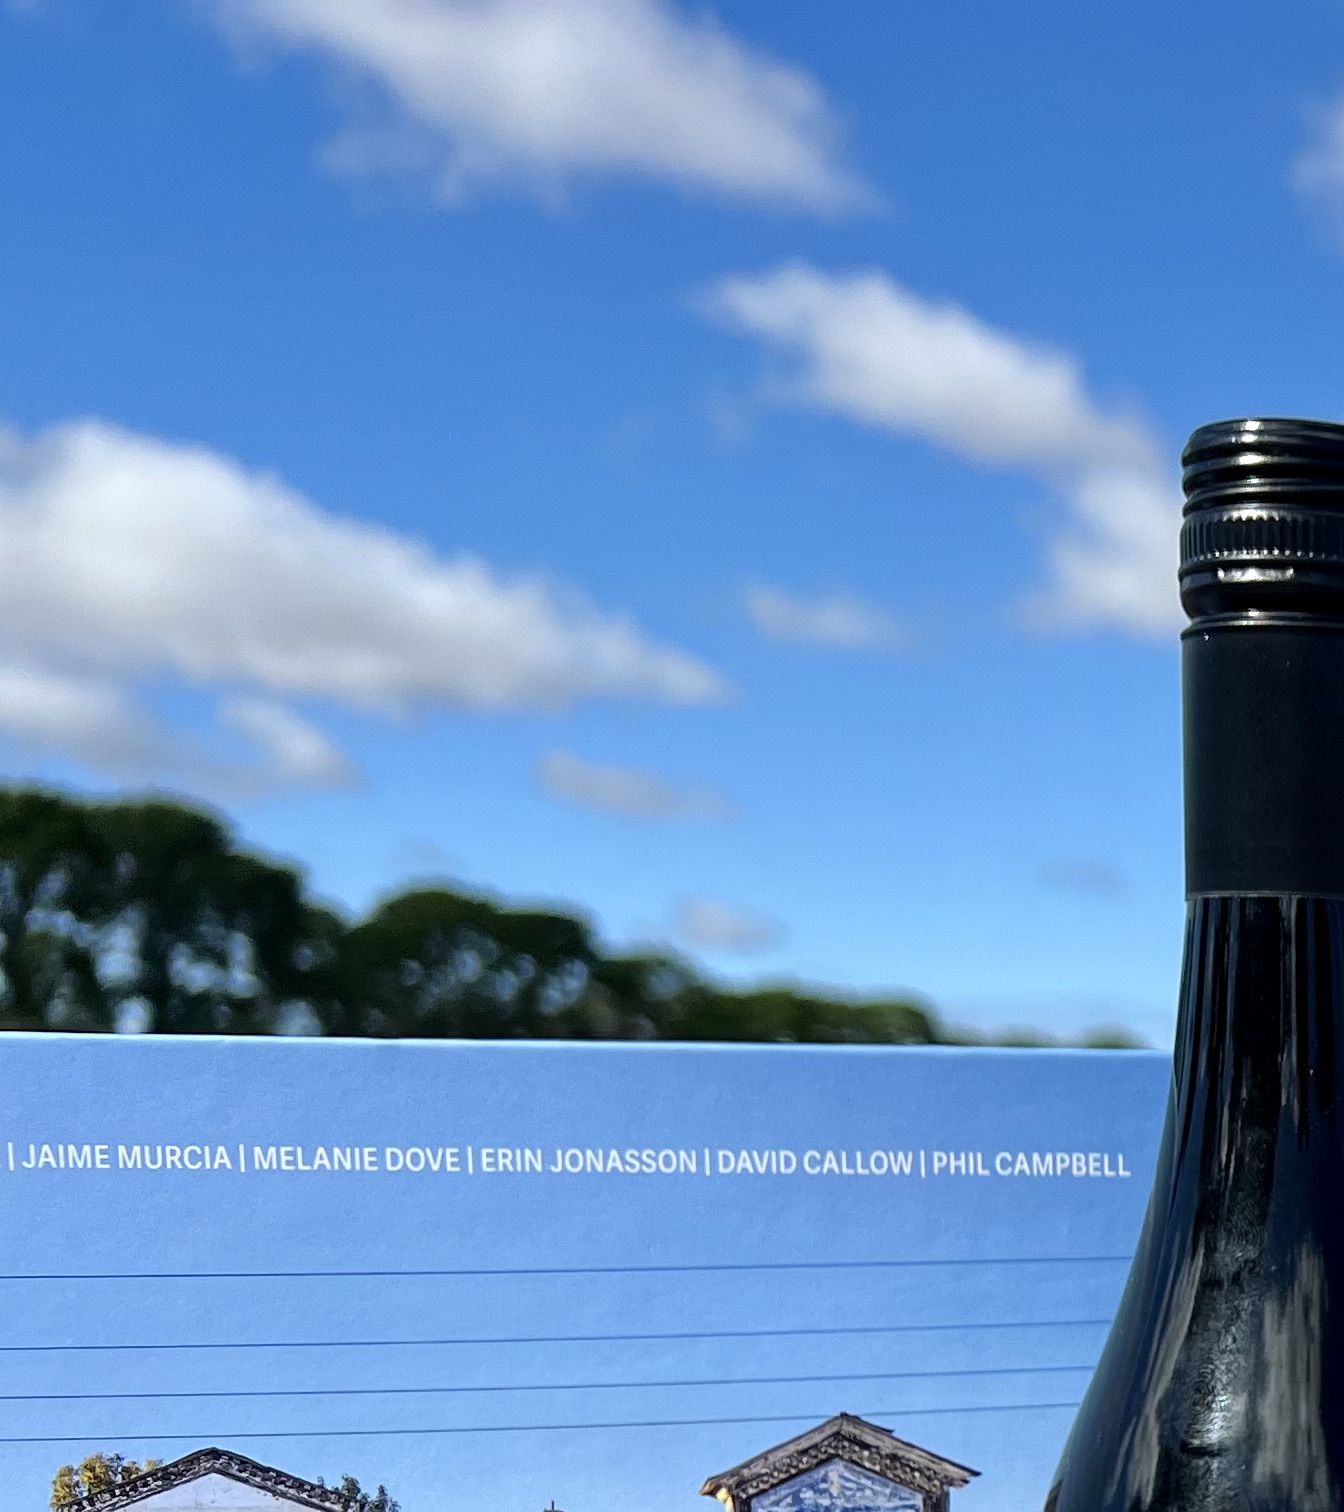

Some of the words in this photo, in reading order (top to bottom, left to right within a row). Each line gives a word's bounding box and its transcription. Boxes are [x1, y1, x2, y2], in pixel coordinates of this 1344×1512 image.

[21, 1143, 110, 1170] JAIME
[118, 1145, 232, 1171] MURCIA
[253, 1146, 378, 1172] MELANIE
[386, 1147, 460, 1173] DOVE
[482, 1148, 543, 1173] ERIN
[549, 1148, 698, 1174] JONASSON
[718, 1149, 797, 1175] DAVID
[803, 1149, 912, 1176] CALLOW
[932, 1150, 990, 1177] PHIL
[995, 1151, 1131, 1178] CAMPBELL
